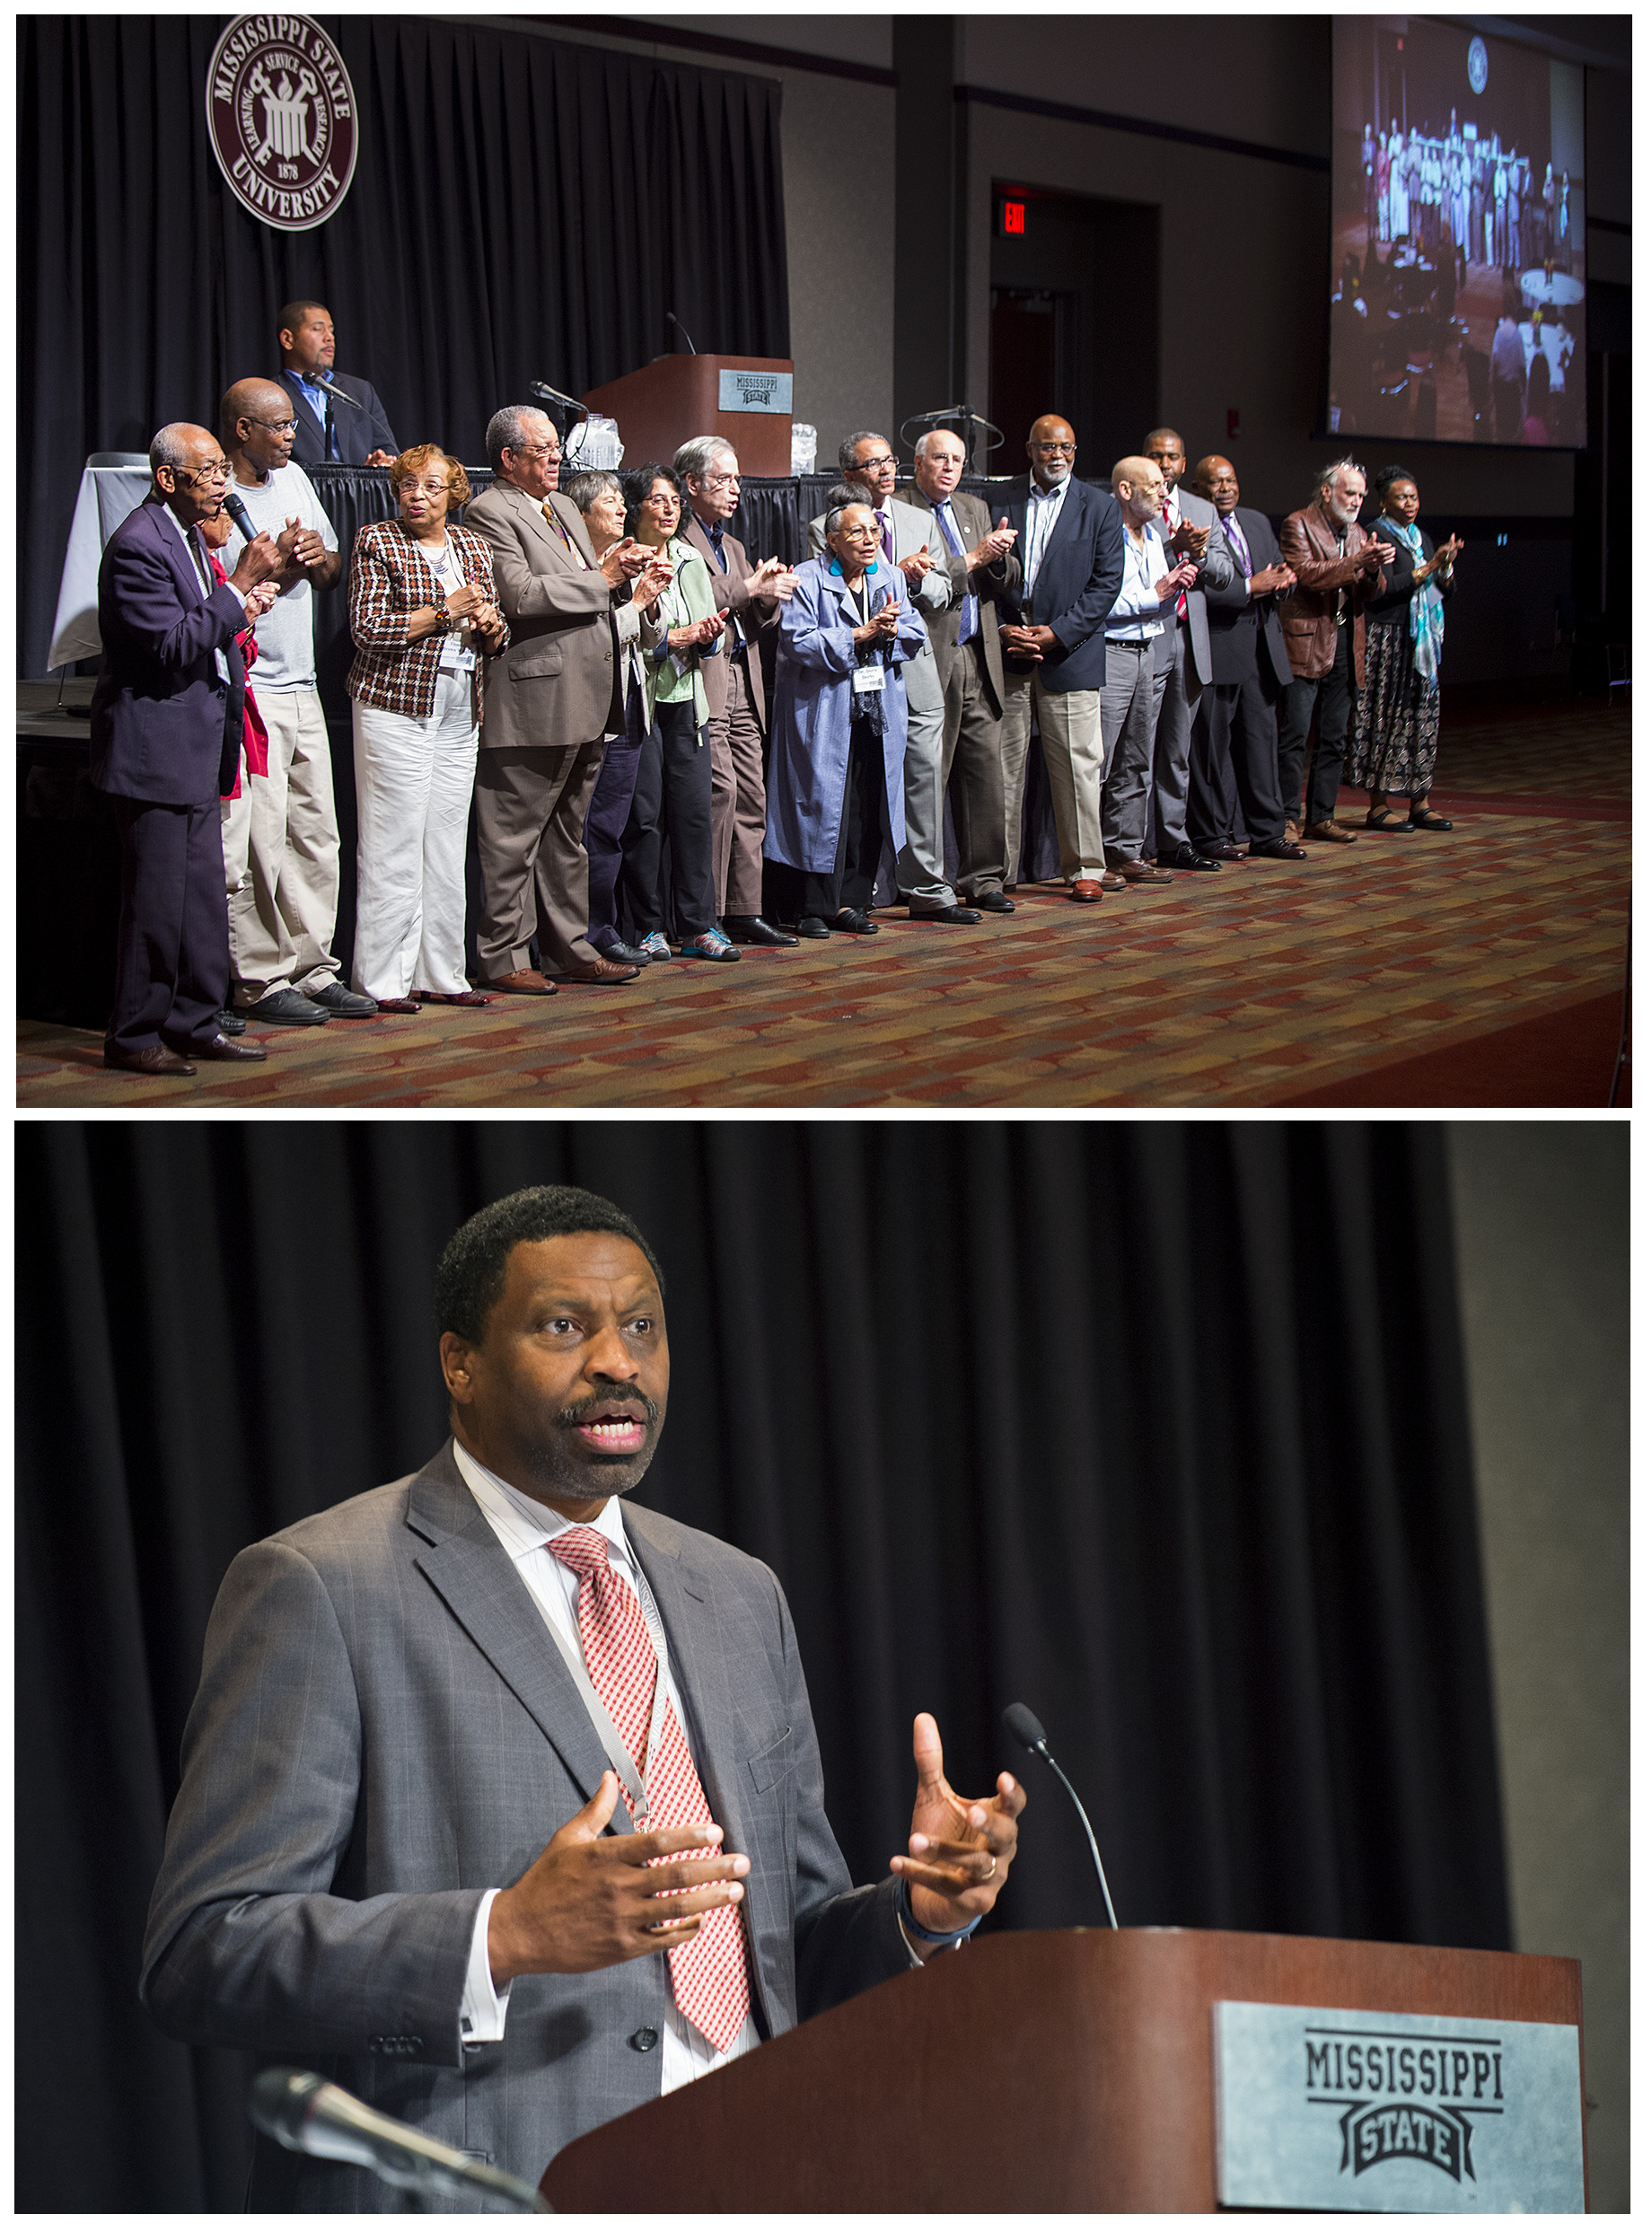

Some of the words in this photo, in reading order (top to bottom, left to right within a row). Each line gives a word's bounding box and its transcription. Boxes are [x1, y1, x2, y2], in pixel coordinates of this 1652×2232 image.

[215, 14, 309, 104] MISSISSIPPI
[310, 39, 351, 119] STATE
[265, 51, 300, 74] SERVICE
[241, 87, 261, 151] LEARNING
[312, 94, 329, 159] RESEARCH
[232, 153, 340, 218] UNIVERSITY
[277, 163, 298, 180] 1878
[1005, 202, 1025, 234] EXIT
[736, 377, 778, 390] MISSISSIPPI
[1305, 2041, 1504, 2099] MISSISSIPPI
[1360, 2109, 1452, 2167] STATE
